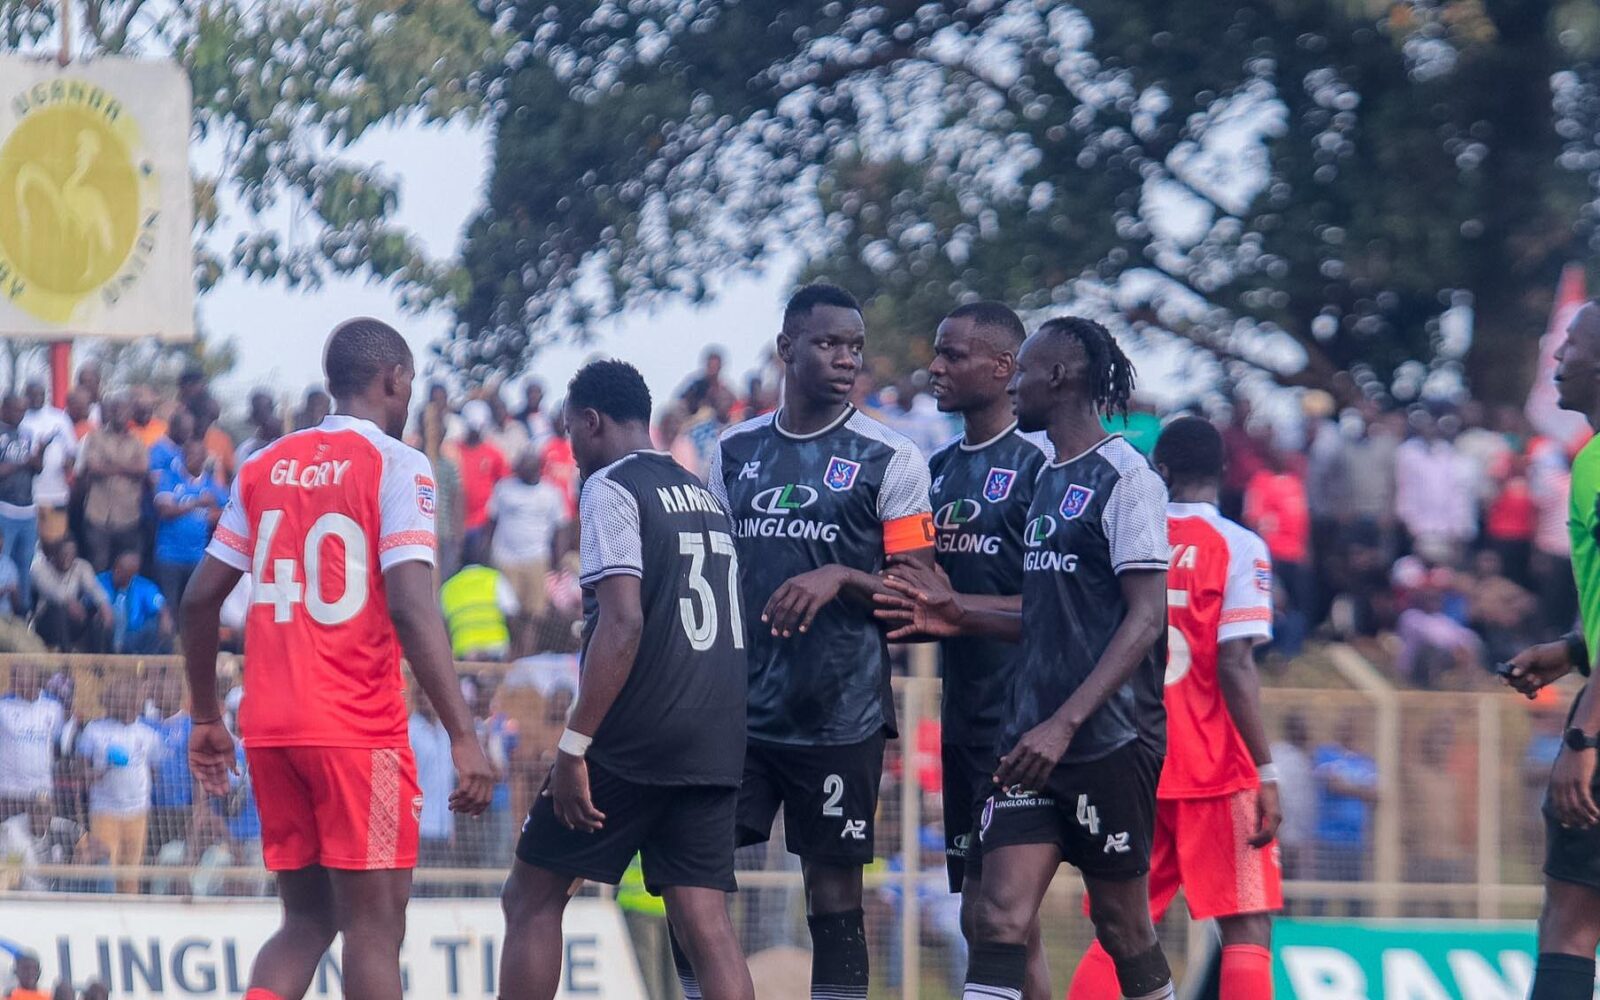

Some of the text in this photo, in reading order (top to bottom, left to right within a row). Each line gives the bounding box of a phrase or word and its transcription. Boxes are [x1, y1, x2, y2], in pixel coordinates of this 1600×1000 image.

[270, 458, 351, 488] GLORY
[738, 518, 840, 542] LINGLONG
[252, 509, 368, 625] 40
[678, 530, 744, 651] 37
[822, 773, 844, 817] 2
[1076, 793, 1100, 834] 4
[840, 819, 866, 839] AZ
[56, 935, 601, 993] LINGLN TIE
